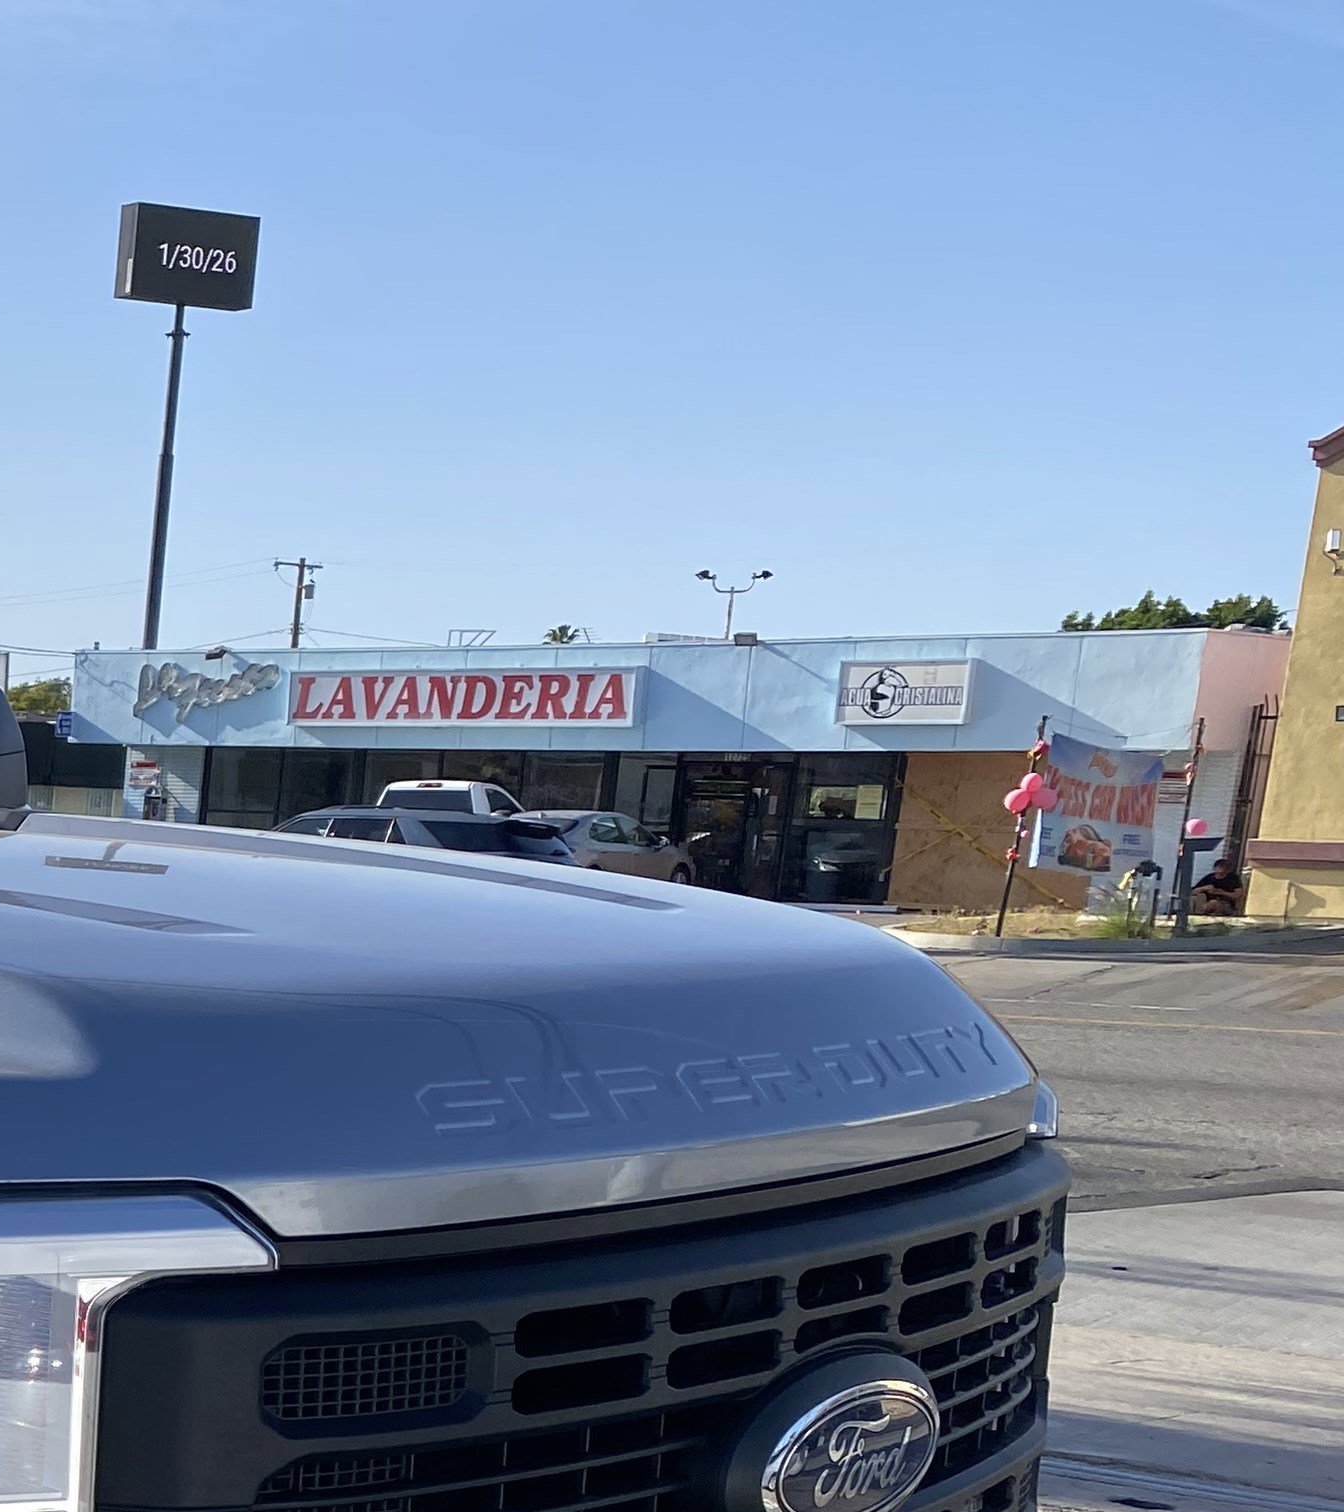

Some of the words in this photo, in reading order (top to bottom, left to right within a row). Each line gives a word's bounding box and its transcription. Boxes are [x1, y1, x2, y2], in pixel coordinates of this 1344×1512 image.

[159, 243, 236, 273] 1/30/26
[292, 674, 627, 720] LAVANDERIA
[840, 687, 872, 706] AGUA
[894, 686, 963, 706] CRISTALINA
[416, 1052, 806, 1136] SUPER
[811, 1022, 998, 1093] DUTY
[813, 1413, 912, 1508] Ford
